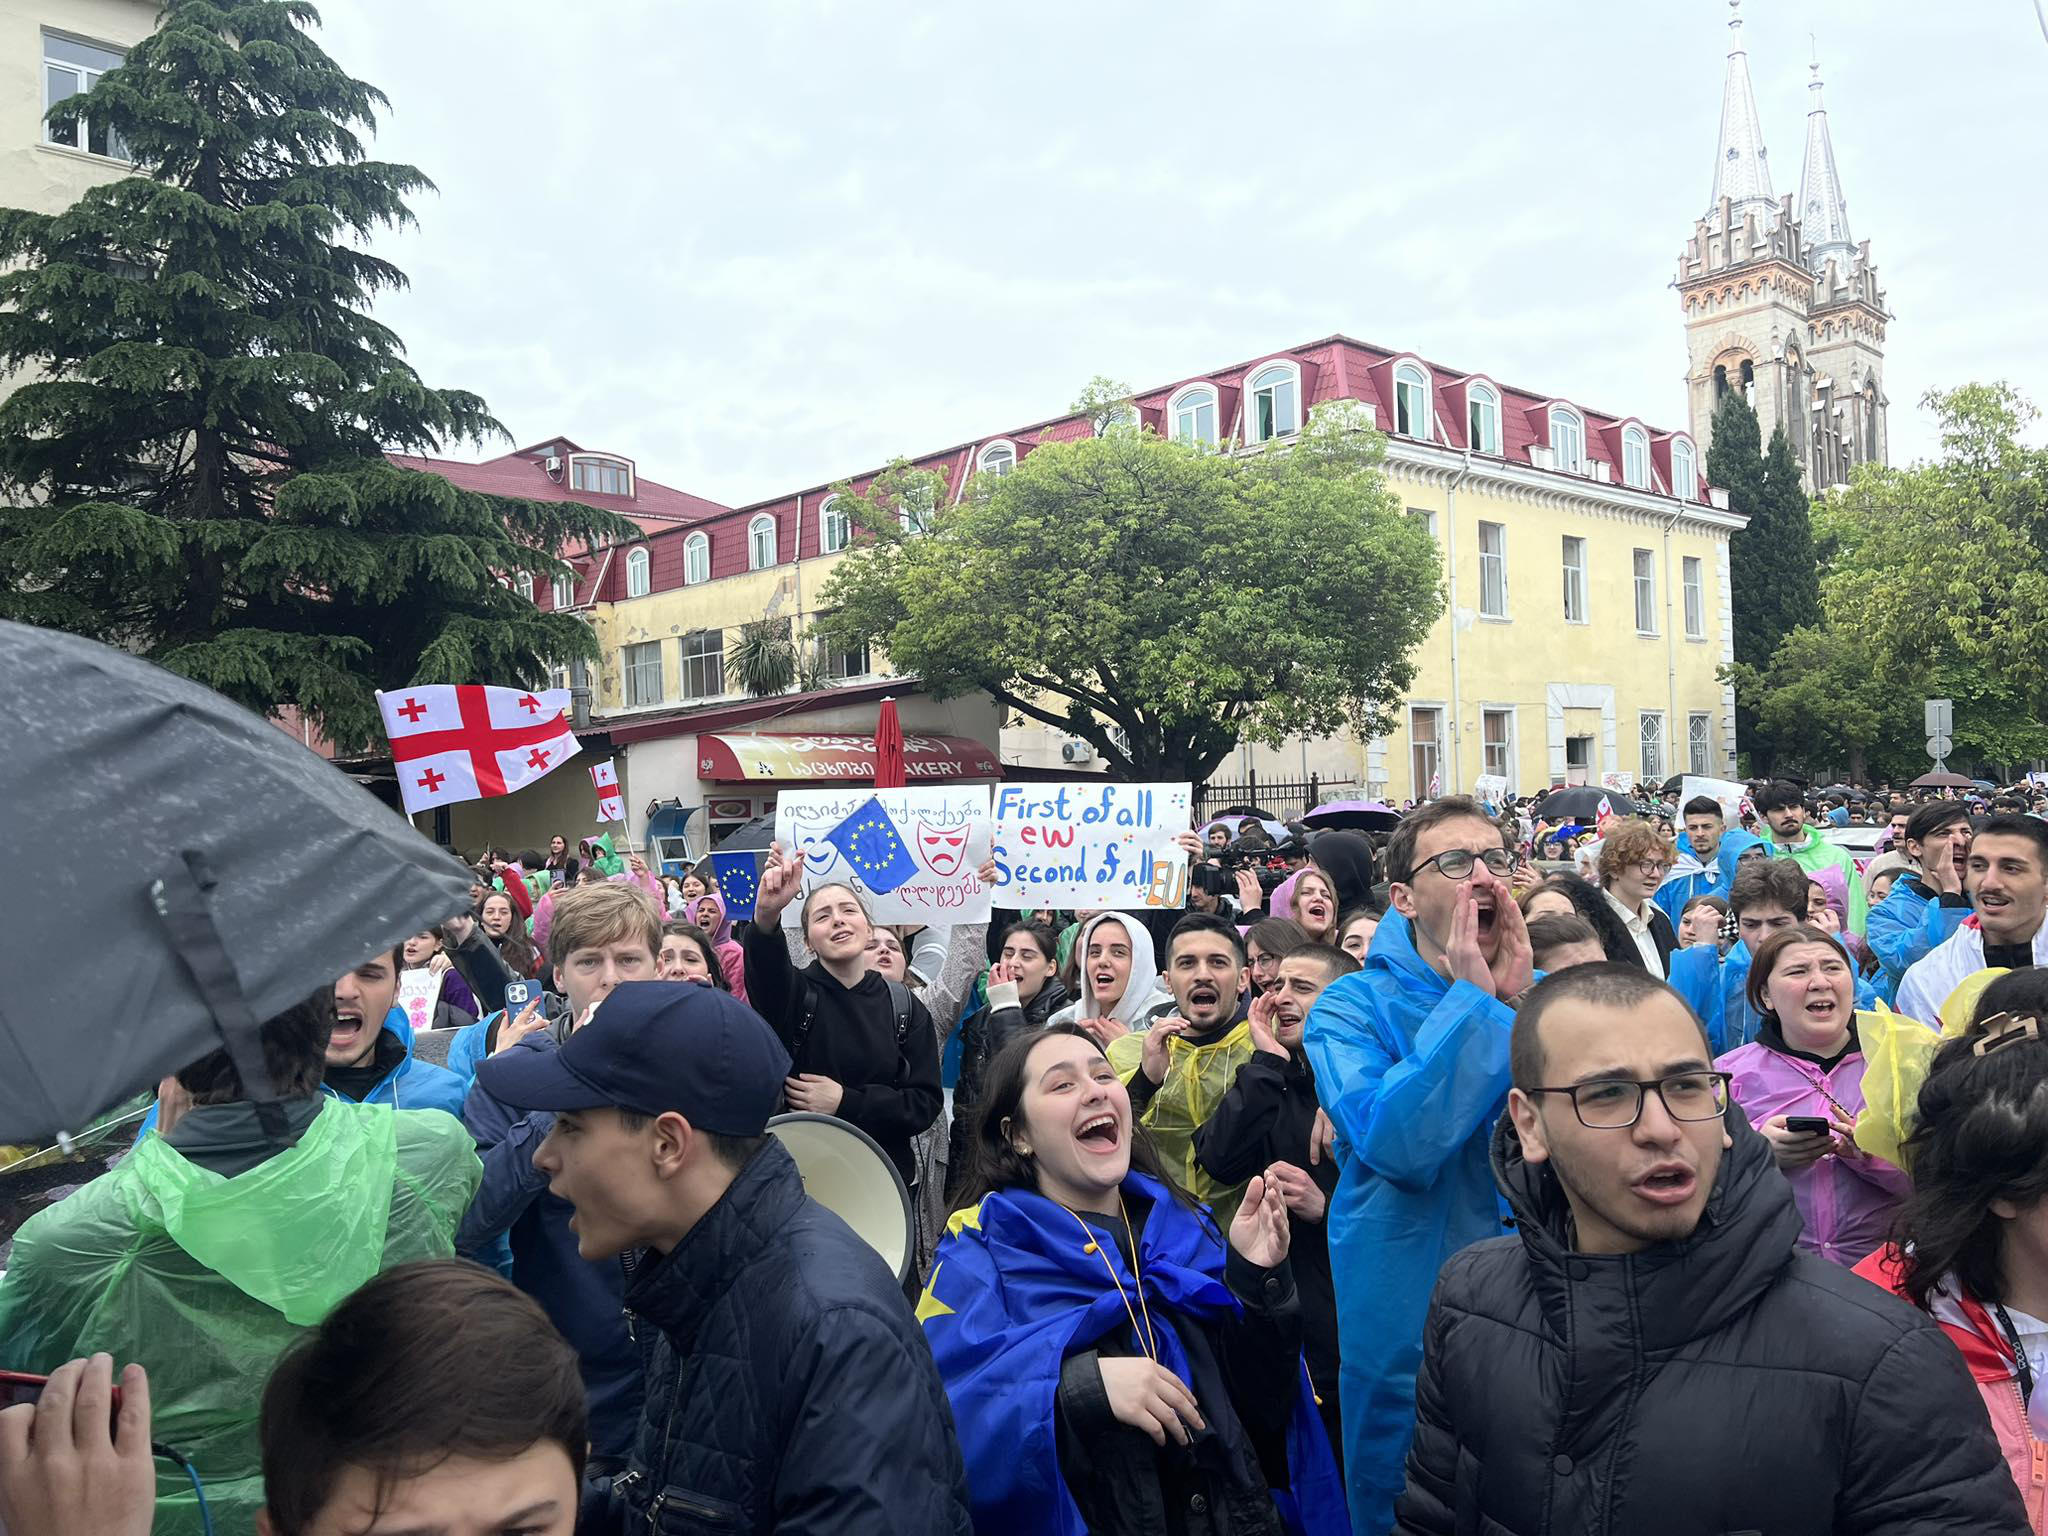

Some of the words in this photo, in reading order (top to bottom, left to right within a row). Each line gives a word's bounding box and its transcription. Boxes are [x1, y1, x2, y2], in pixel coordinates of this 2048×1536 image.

[787, 761, 875, 776] საცხობი
[904, 761, 962, 776] AKERY
[997, 787, 1073, 821] First
[1082, 786, 1116, 824] of
[1020, 825, 1075, 848] ew
[992, 845, 1088, 887] Second
[1096, 842, 1121, 883] of
[1123, 849, 1153, 886] all
[1145, 860, 1186, 908] EU
